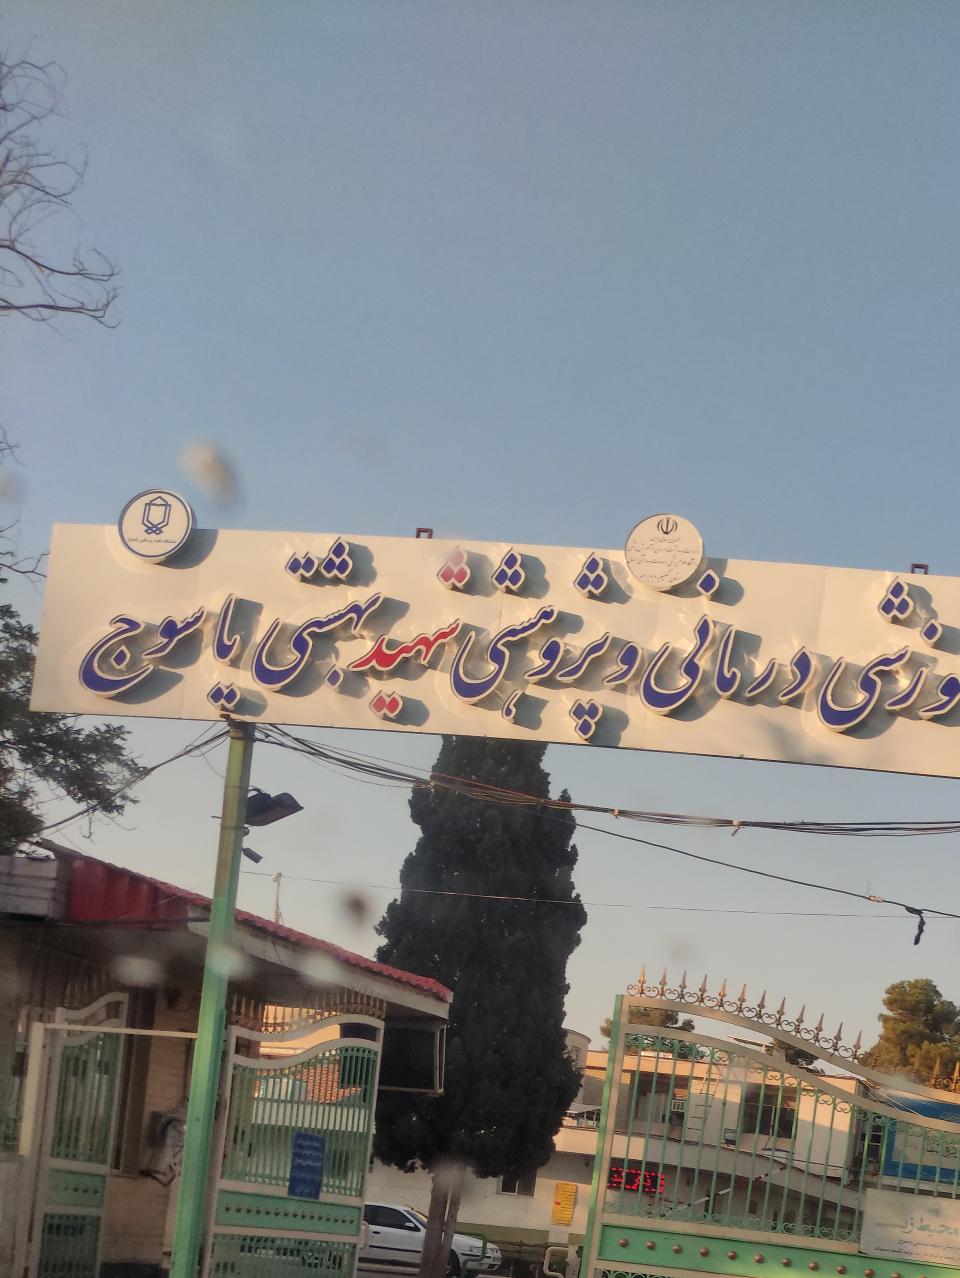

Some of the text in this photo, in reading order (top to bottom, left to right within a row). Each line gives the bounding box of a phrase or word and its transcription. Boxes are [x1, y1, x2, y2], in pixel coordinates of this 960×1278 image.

[79, 592, 240, 710] یاسوج
[251, 537, 384, 691] بهشتی
[349, 545, 463, 719] شهید
[450, 546, 612, 740] پژوهشی
[604, 643, 642, 686] و
[639, 568, 815, 715] درمانی
[915, 1216, 958, 1237] محیط
